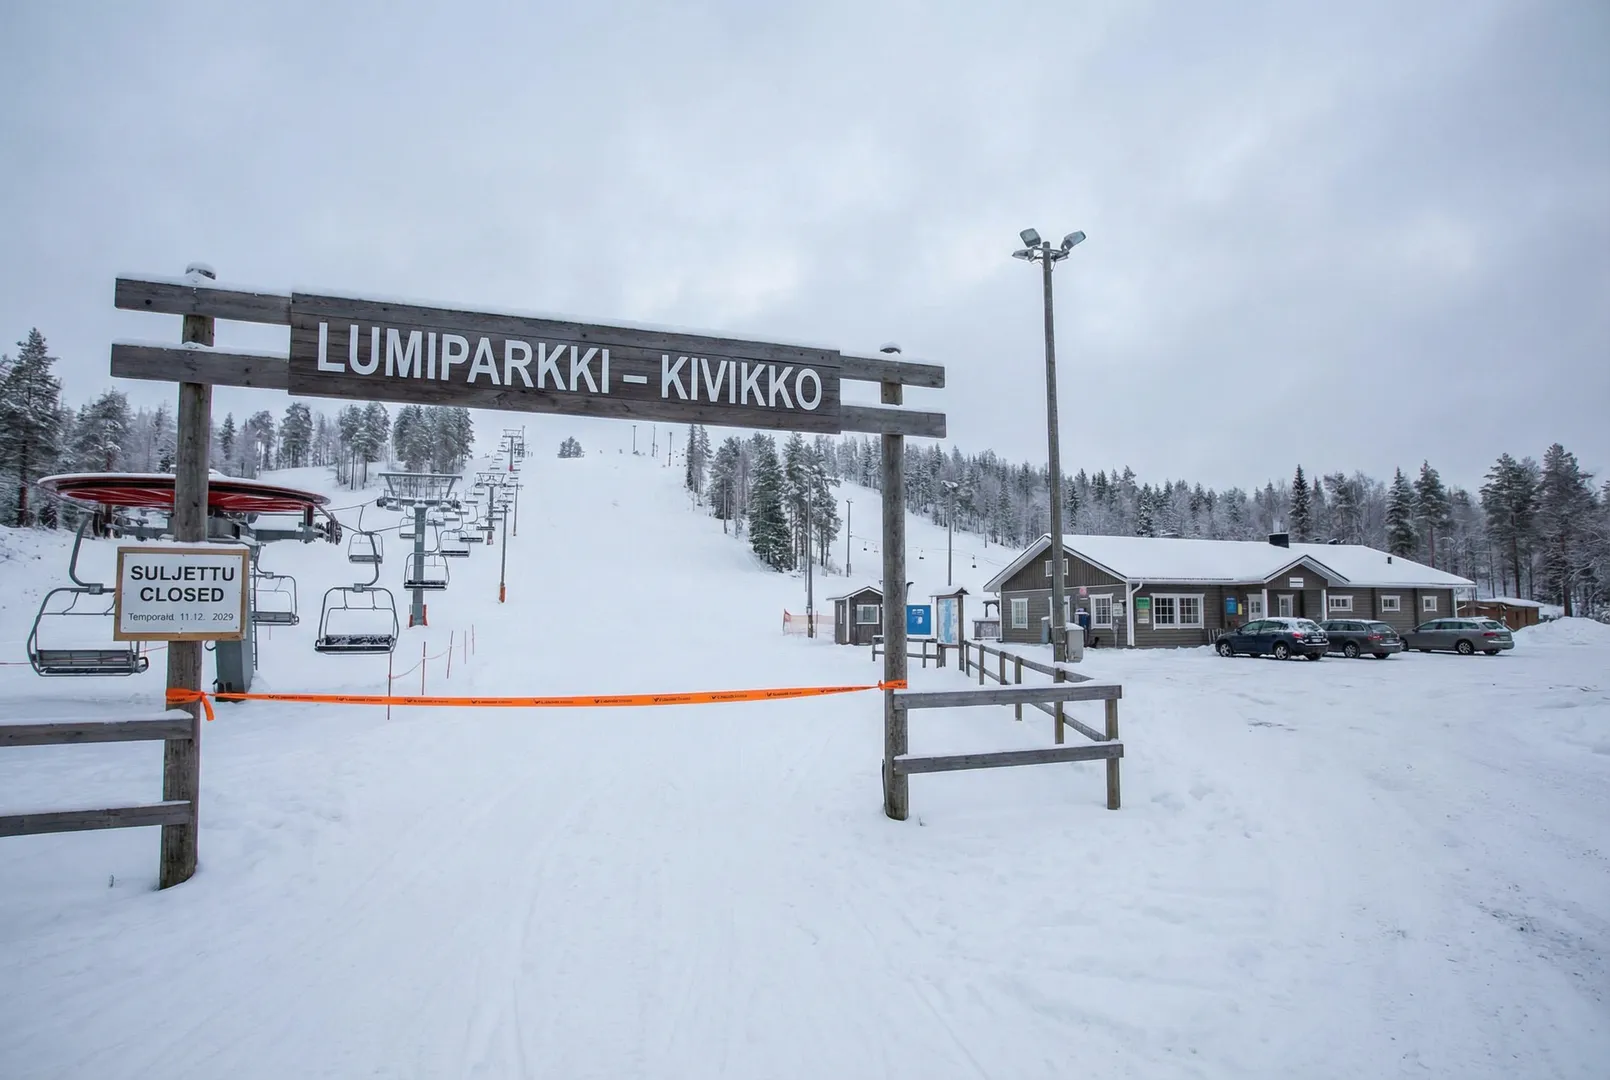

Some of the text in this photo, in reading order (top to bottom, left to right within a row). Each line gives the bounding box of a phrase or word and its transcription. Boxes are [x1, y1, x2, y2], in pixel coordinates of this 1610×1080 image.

[317, 321, 610, 395] LUMIPARKKI
[661, 354, 823, 411] KIVIKKO
[130, 565, 234, 581] SULJETTU
[140, 586, 224, 601] CLOSED
[181, 613, 206, 621] 11.12.
[212, 613, 234, 621] 2029
